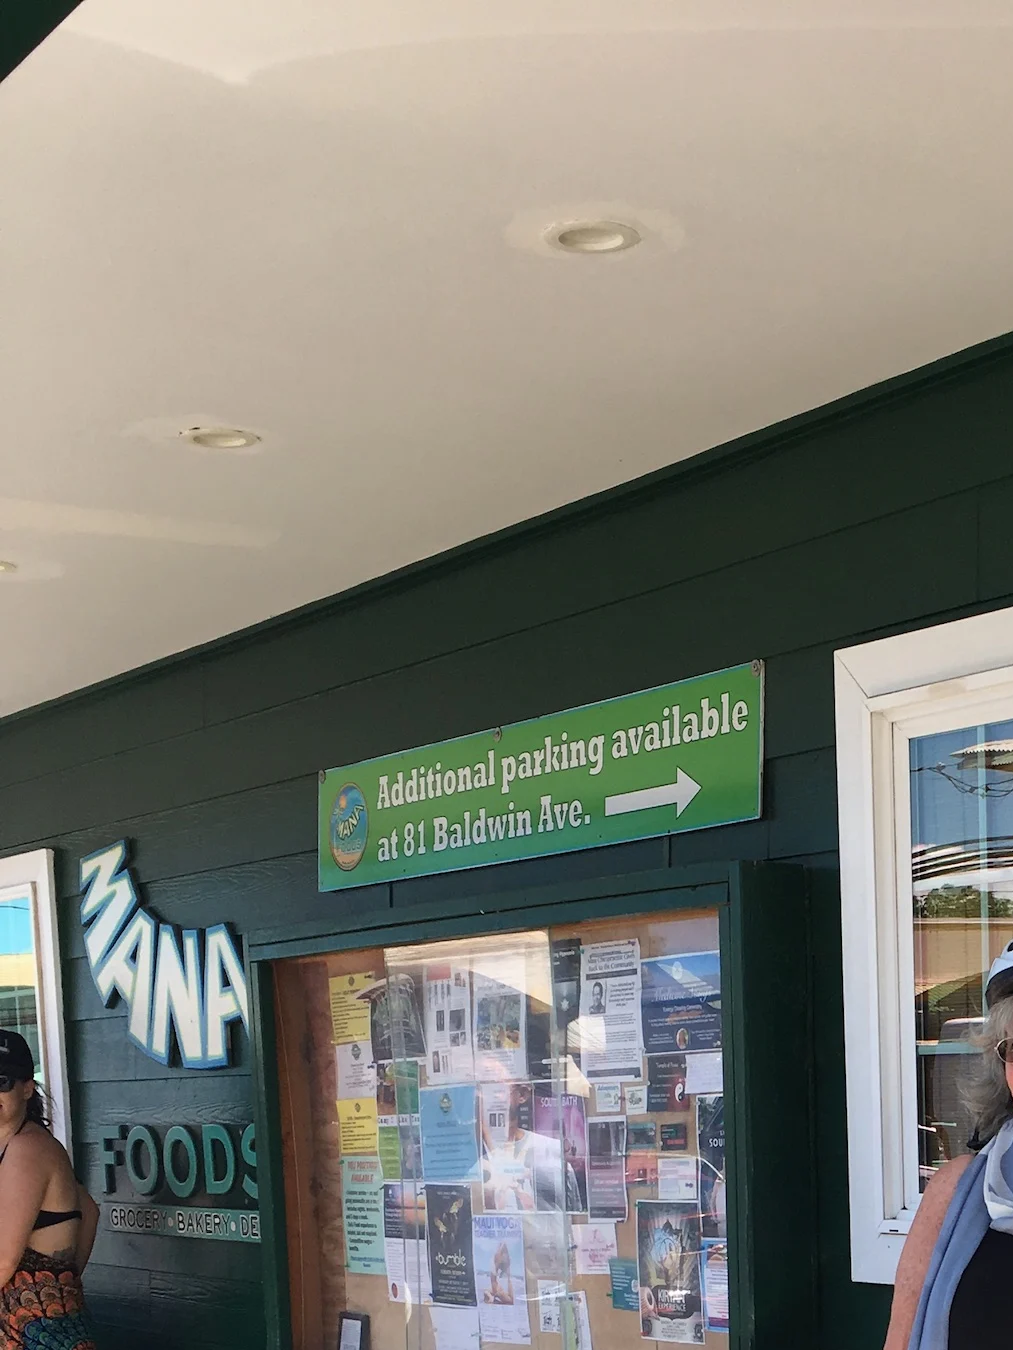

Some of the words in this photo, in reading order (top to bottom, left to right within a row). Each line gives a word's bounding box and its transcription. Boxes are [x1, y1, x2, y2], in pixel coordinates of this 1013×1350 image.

[377, 749, 496, 810] Additional
[501, 731, 605, 794] parking
[611, 692, 749, 760] available
[337, 805, 364, 839] MANA
[377, 828, 399, 862] at
[403, 820, 426, 857] 81
[432, 801, 533, 852] Baldwin
[537, 794, 591, 833] Ave.
[79, 840, 250, 1069] MANA
[561, 1095, 578, 1107] BATH
[709, 1137, 725, 1148] SOU
[98, 1123, 259, 1200] FOODS
[110, 1207, 168, 1231] GROCERY
[176, 1211, 231, 1236] BAKERY
[240, 1214, 260, 1239] DE
[474, 1216, 495, 1229] MAUI
[657, 1288, 686, 1304] KIRT
